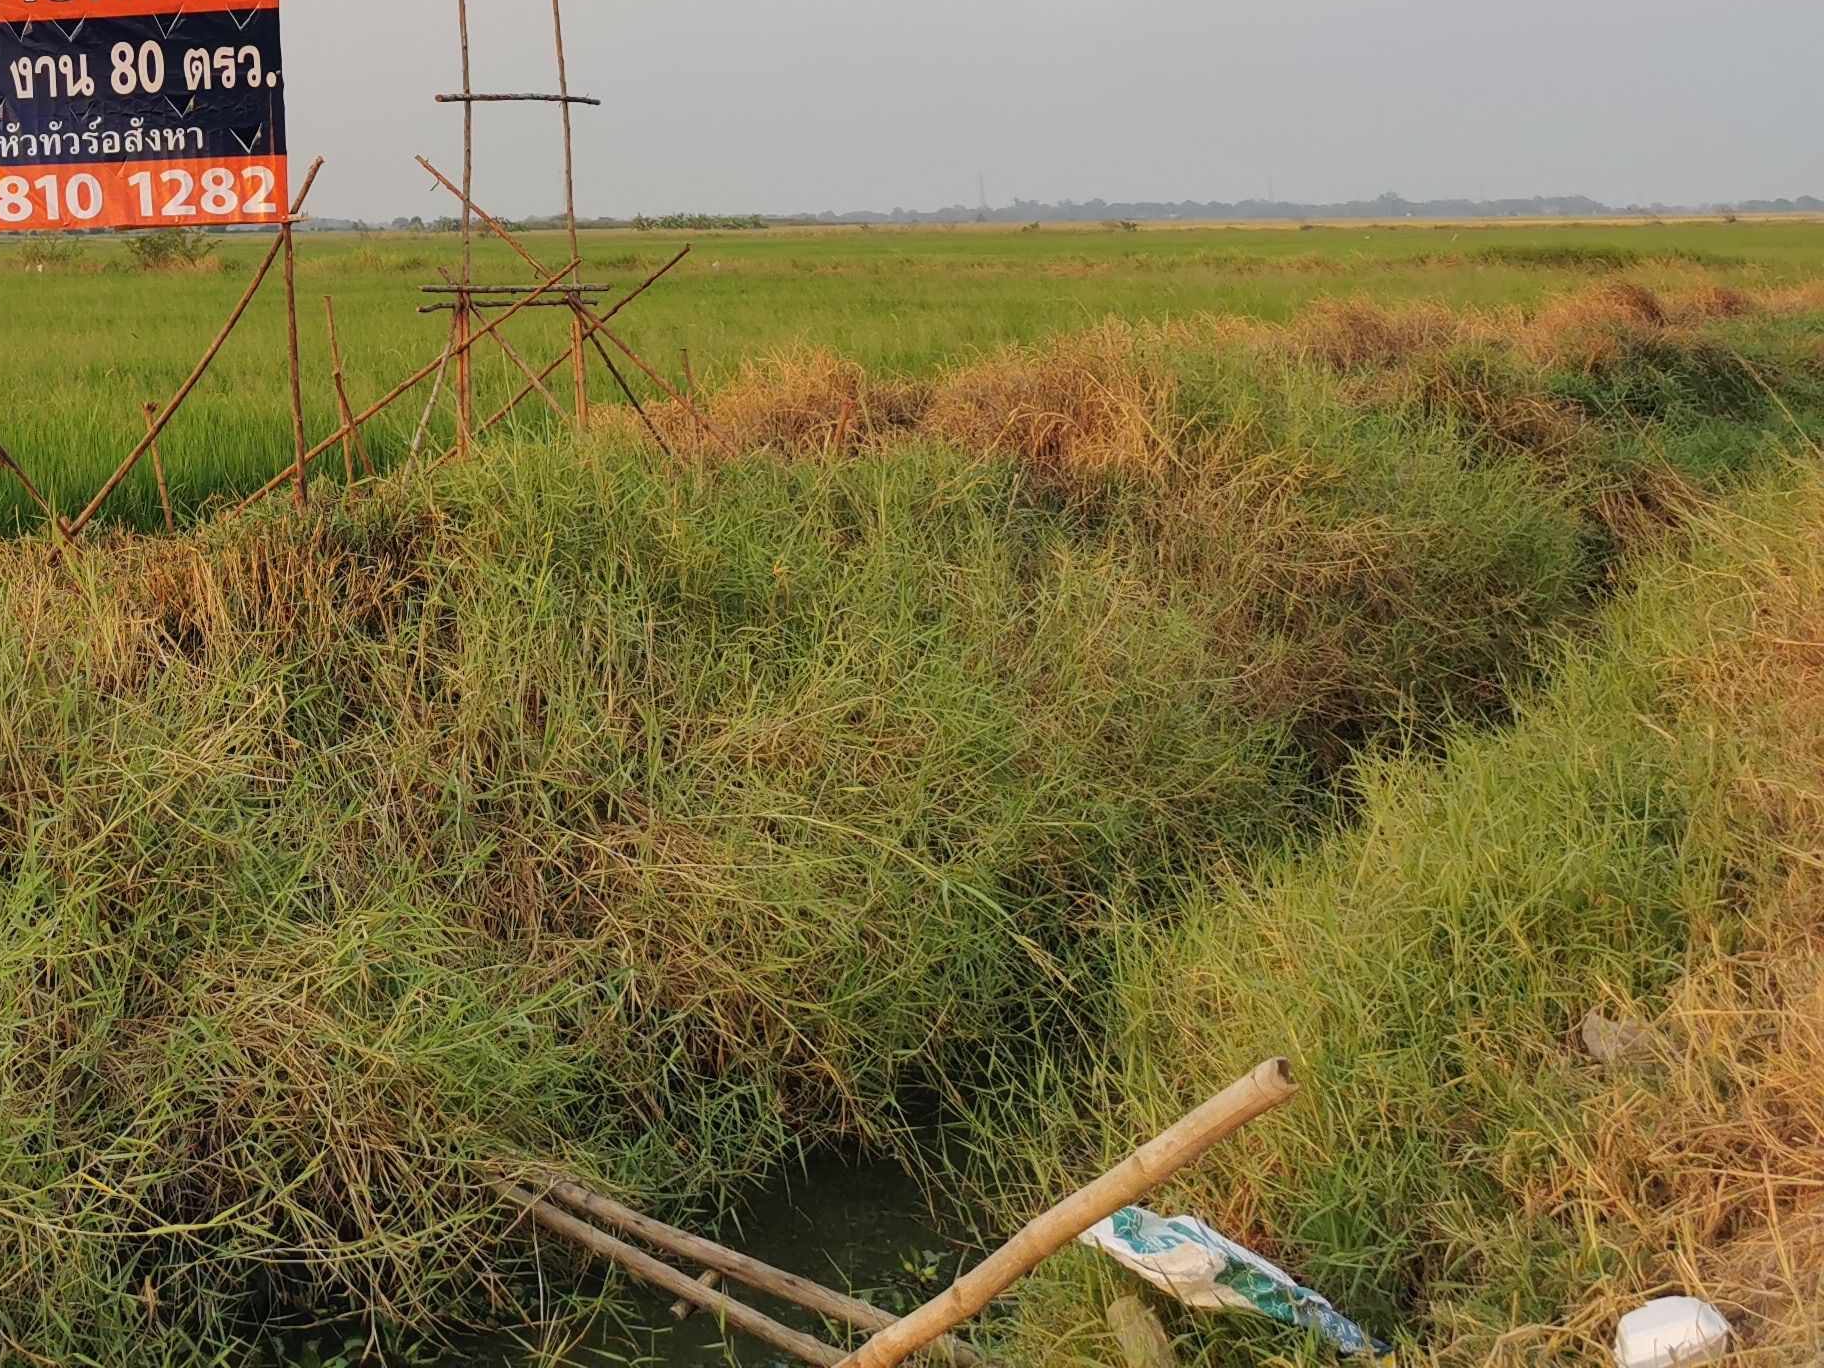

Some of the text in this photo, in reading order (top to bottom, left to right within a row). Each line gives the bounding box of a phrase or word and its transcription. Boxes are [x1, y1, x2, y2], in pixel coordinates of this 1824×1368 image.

[10, 53, 94, 98] งาน
[110, 40, 165, 94] 80
[184, 44, 277, 91] ตรว.
[128, 165, 276, 217] 1282
